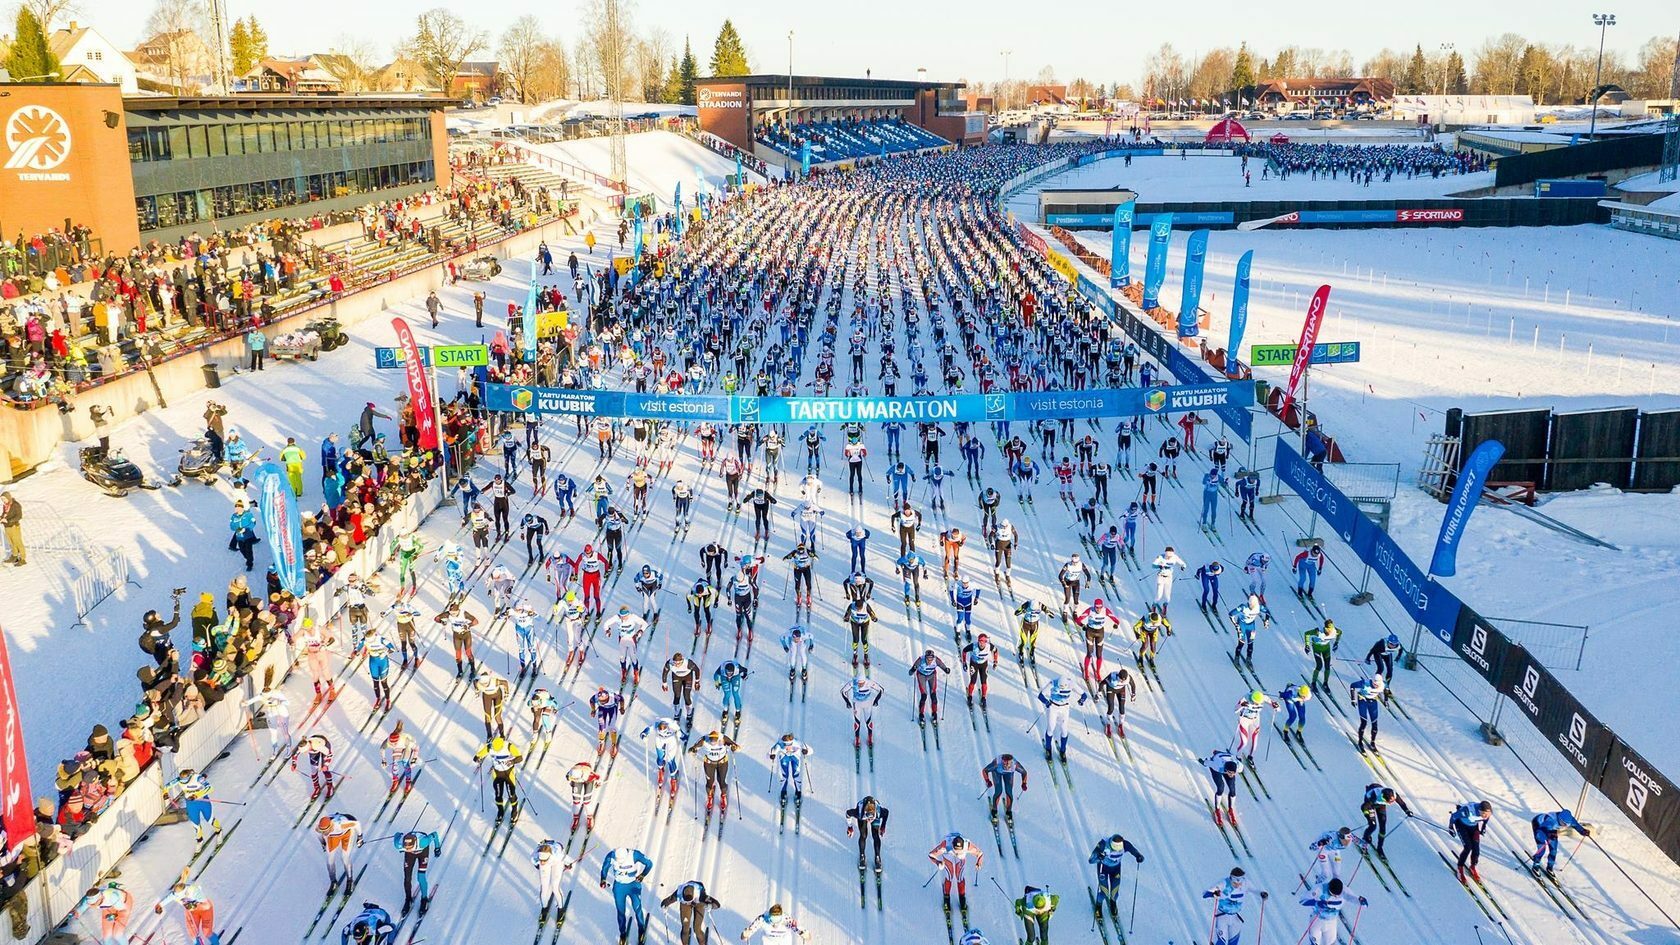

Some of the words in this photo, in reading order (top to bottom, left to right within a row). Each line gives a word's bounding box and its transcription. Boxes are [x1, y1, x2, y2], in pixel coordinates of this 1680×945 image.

[699, 100, 743, 108] STAADION
[1412, 210, 1462, 220] SPORTLAND
[1292, 296, 1322, 379] SPORTLAND
[440, 349, 483, 364] START
[538, 399, 596, 413] KUUBIK
[640, 400, 667, 412] visit
[669, 401, 715, 414] estonia
[787, 400, 852, 420] TARTU
[857, 400, 957, 420] MARATON
[1030, 398, 1057, 411] visit
[1059, 397, 1104, 410] estonia
[1172, 393, 1228, 408] KUUBIK
[1290, 461, 1307, 493] visit
[1442, 469, 1477, 545] WORLDLOPPET
[1375, 540, 1394, 574] visit
[1392, 563, 1429, 612] estonia
[1462, 643, 1490, 672] salomon
[1513, 684, 1539, 716] salomon
[1558, 732, 1588, 769] salomon
[1622, 755, 1663, 797] salomon
